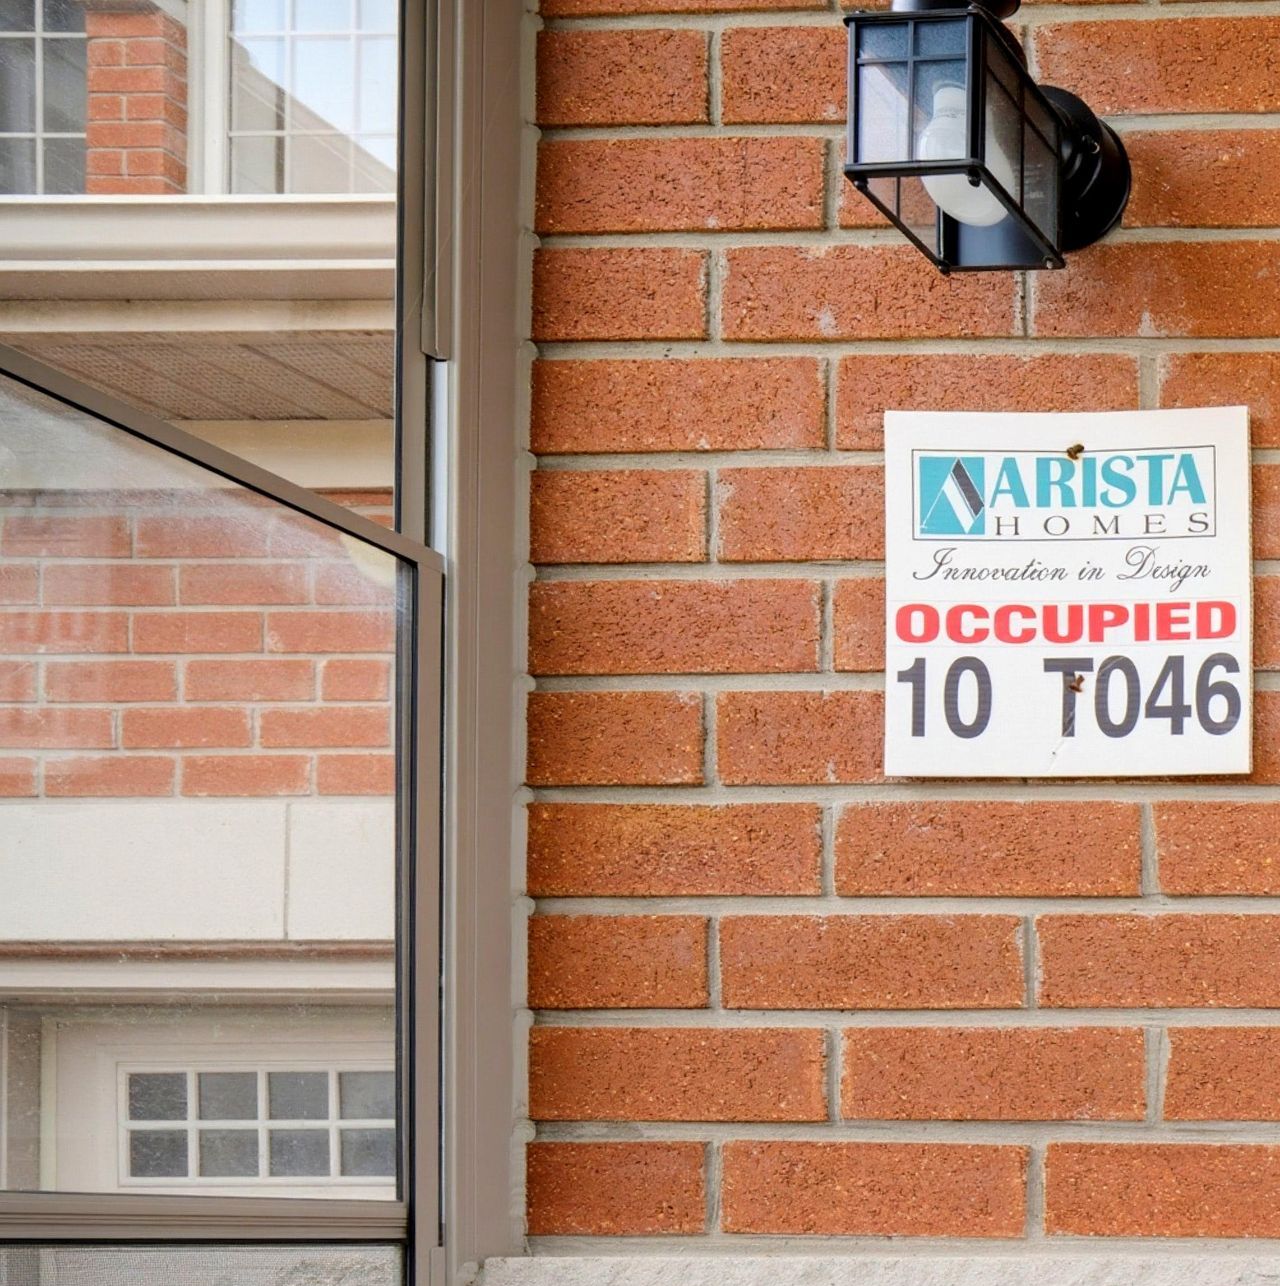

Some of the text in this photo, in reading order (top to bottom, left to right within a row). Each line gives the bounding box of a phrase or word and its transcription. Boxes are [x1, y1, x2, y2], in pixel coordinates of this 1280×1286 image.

[989, 453, 1206, 508] ARISTA
[994, 512, 1209, 537] HOMES
[912, 545, 1211, 592] Innovation in Design
[895, 600, 1236, 644] OCCUPIED
[896, 652, 1242, 739] 10 T046
